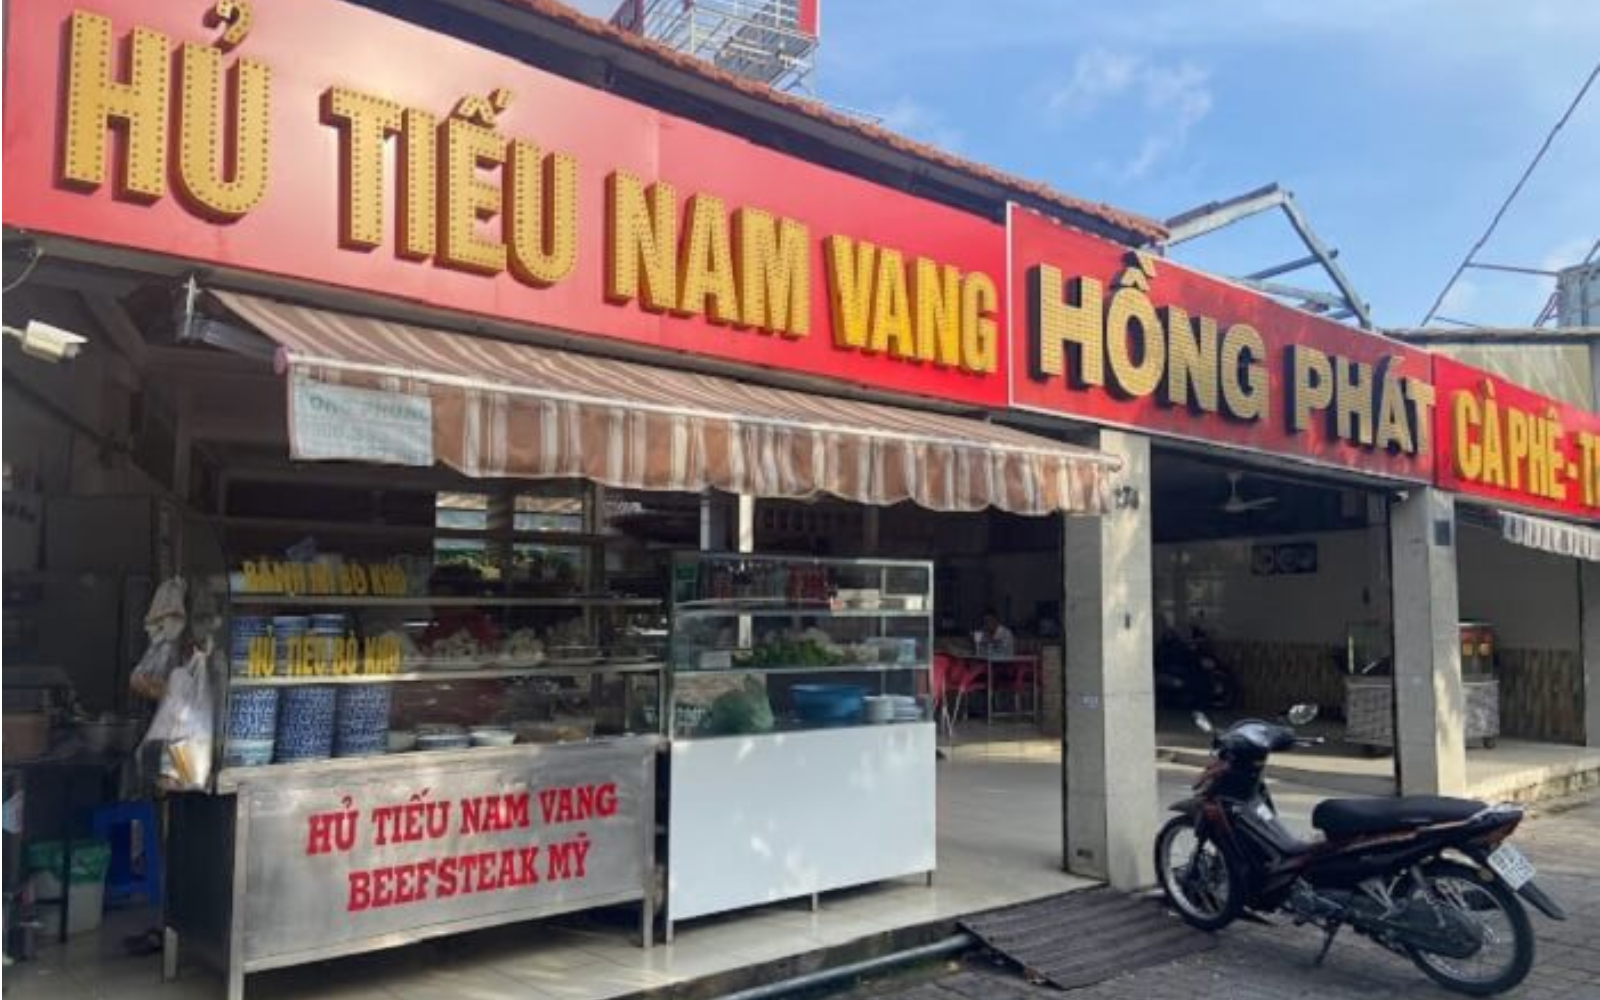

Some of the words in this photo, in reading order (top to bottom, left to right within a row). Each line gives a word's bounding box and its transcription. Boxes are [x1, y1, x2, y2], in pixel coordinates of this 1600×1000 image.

[56, 0, 271, 222] HỦ
[321, 86, 578, 289] TIẾU
[605, 167, 810, 338] NAM
[823, 234, 997, 375] VANG
[1026, 251, 1270, 422] HỒNG
[1286, 344, 1436, 458] PHÁT
[1452, 378, 1506, 486] CÀ
[306, 796, 359, 855] HỦ
[372, 788, 450, 845] TIẾU
[460, 792, 532, 834] NAM
[537, 783, 619, 823] VANG
[347, 846, 540, 911] BEEFSTEAK
